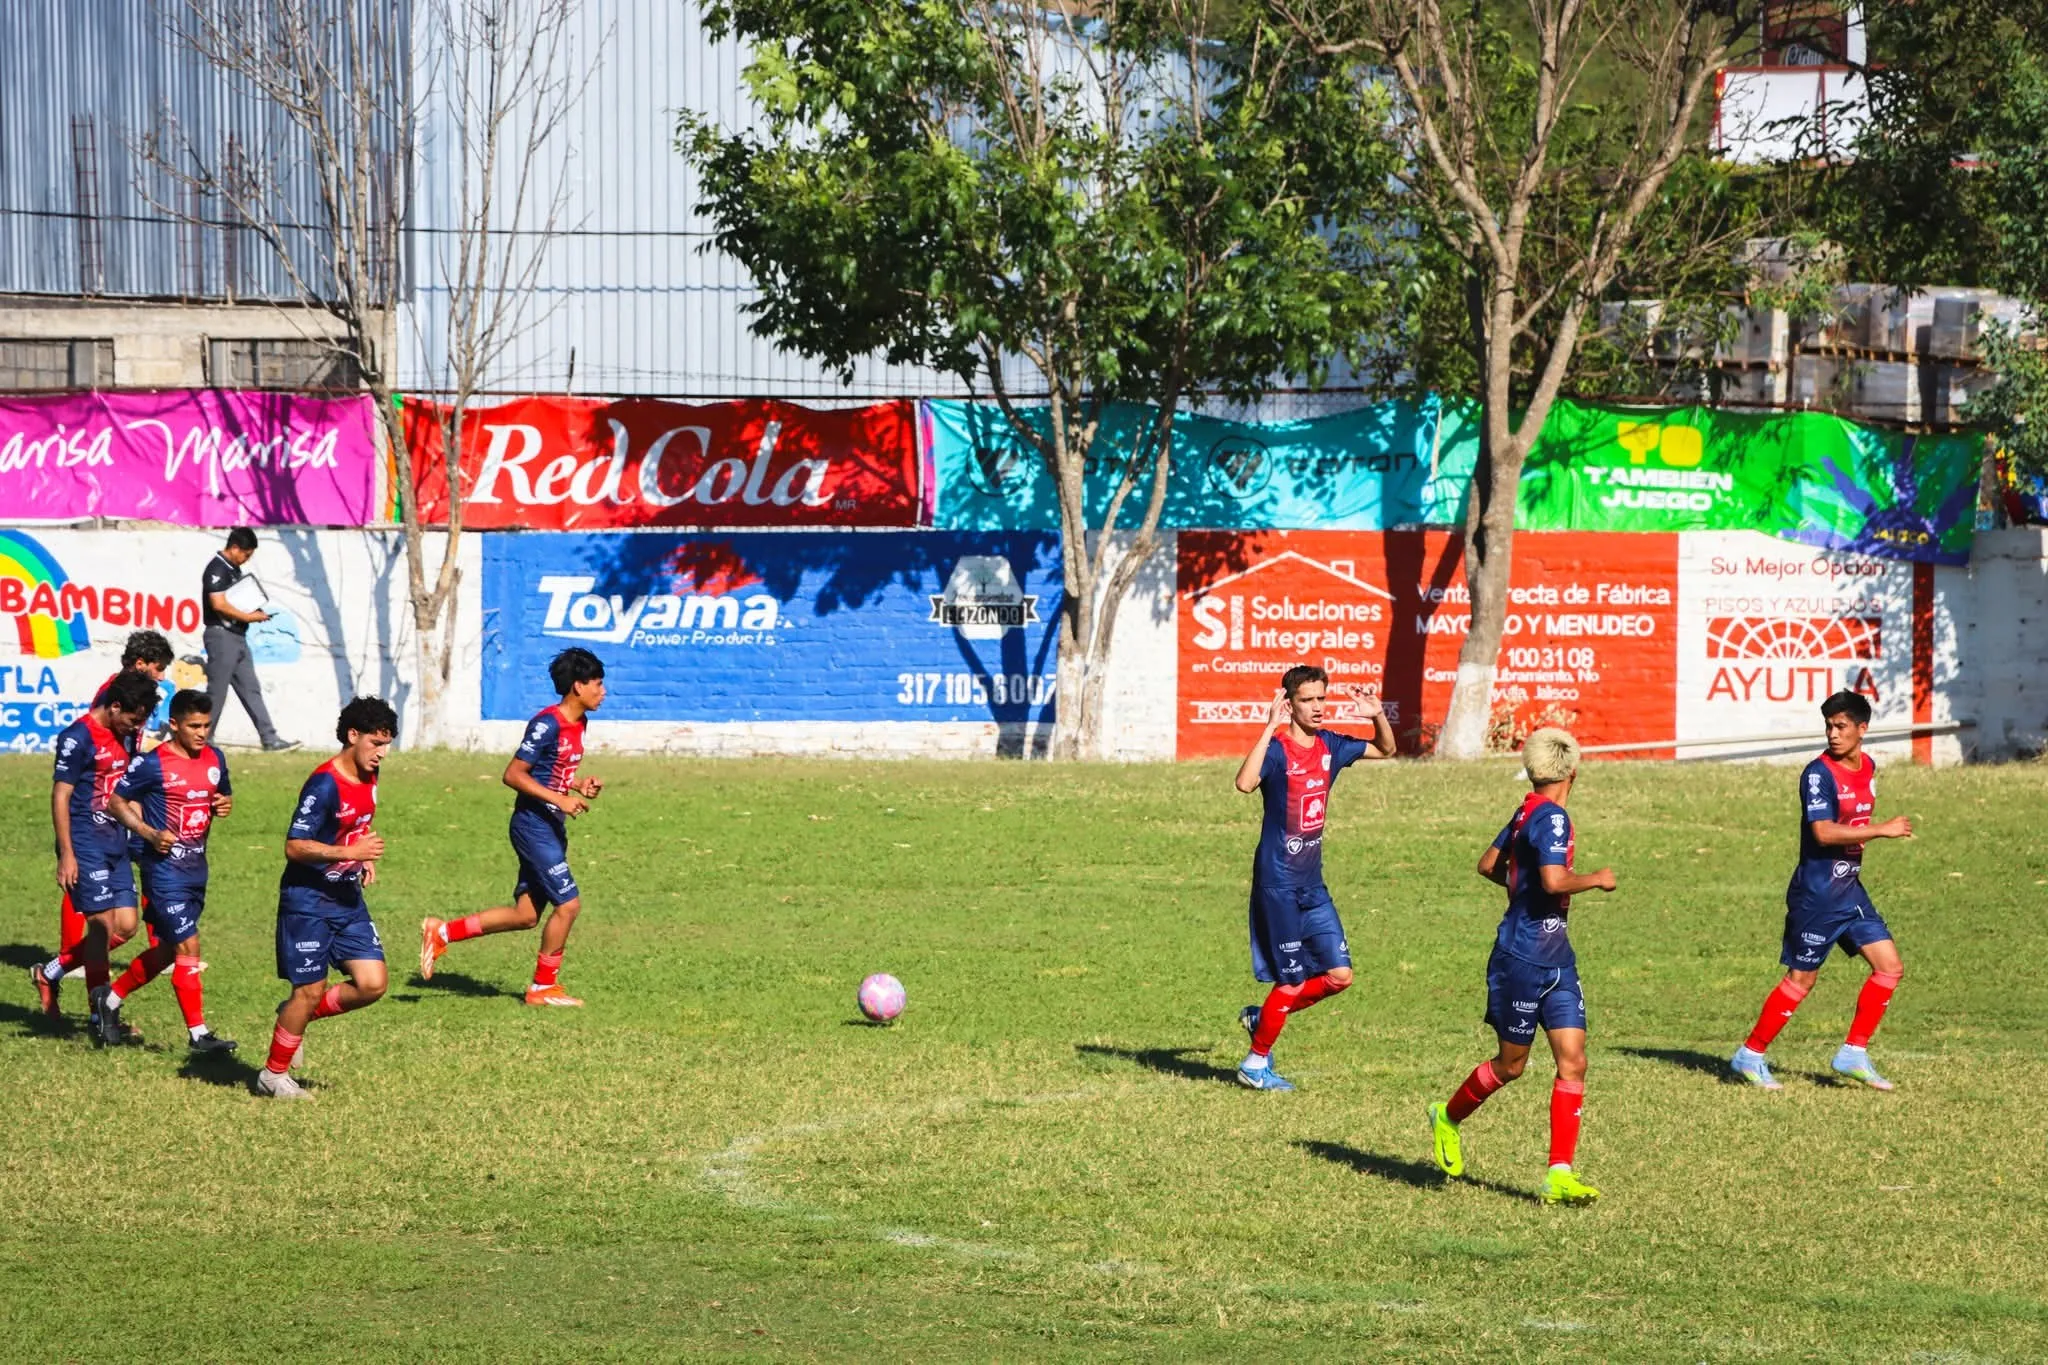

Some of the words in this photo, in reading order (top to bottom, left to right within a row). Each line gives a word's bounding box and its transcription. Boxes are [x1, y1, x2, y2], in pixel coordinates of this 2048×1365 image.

[0, 424, 114, 473] arisa
[126, 419, 338, 497] Marisa
[1617, 421, 1703, 467] YO
[467, 419, 635, 505] Red
[638, 425, 834, 507] Cola
[1600, 489, 1712, 511] JUEGO
[1711, 557, 1737, 575] Su
[1746, 557, 1805, 581] Mejor
[1811, 557, 1886, 581] Opción
[0, 577, 200, 634] BAMBINO
[1563, 583, 1590, 604] de
[1596, 583, 1672, 605] Fábrica
[1705, 598, 1763, 614] PISOS
[1769, 598, 1783, 613] Y
[538, 575, 779, 643] Toyama
[1192, 595, 1245, 651] SI
[1251, 596, 1383, 622] Soluciones
[1415, 614, 1523, 636] MAYOO
[1526, 615, 1543, 635] Y
[1545, 615, 1656, 637] MENUDEO
[1251, 626, 1376, 655] Integrales
[1191, 663, 1210, 673] en
[897, 672, 942, 705] 317
[946, 672, 988, 705] 105
[1198, 703, 1243, 721] PISOS
